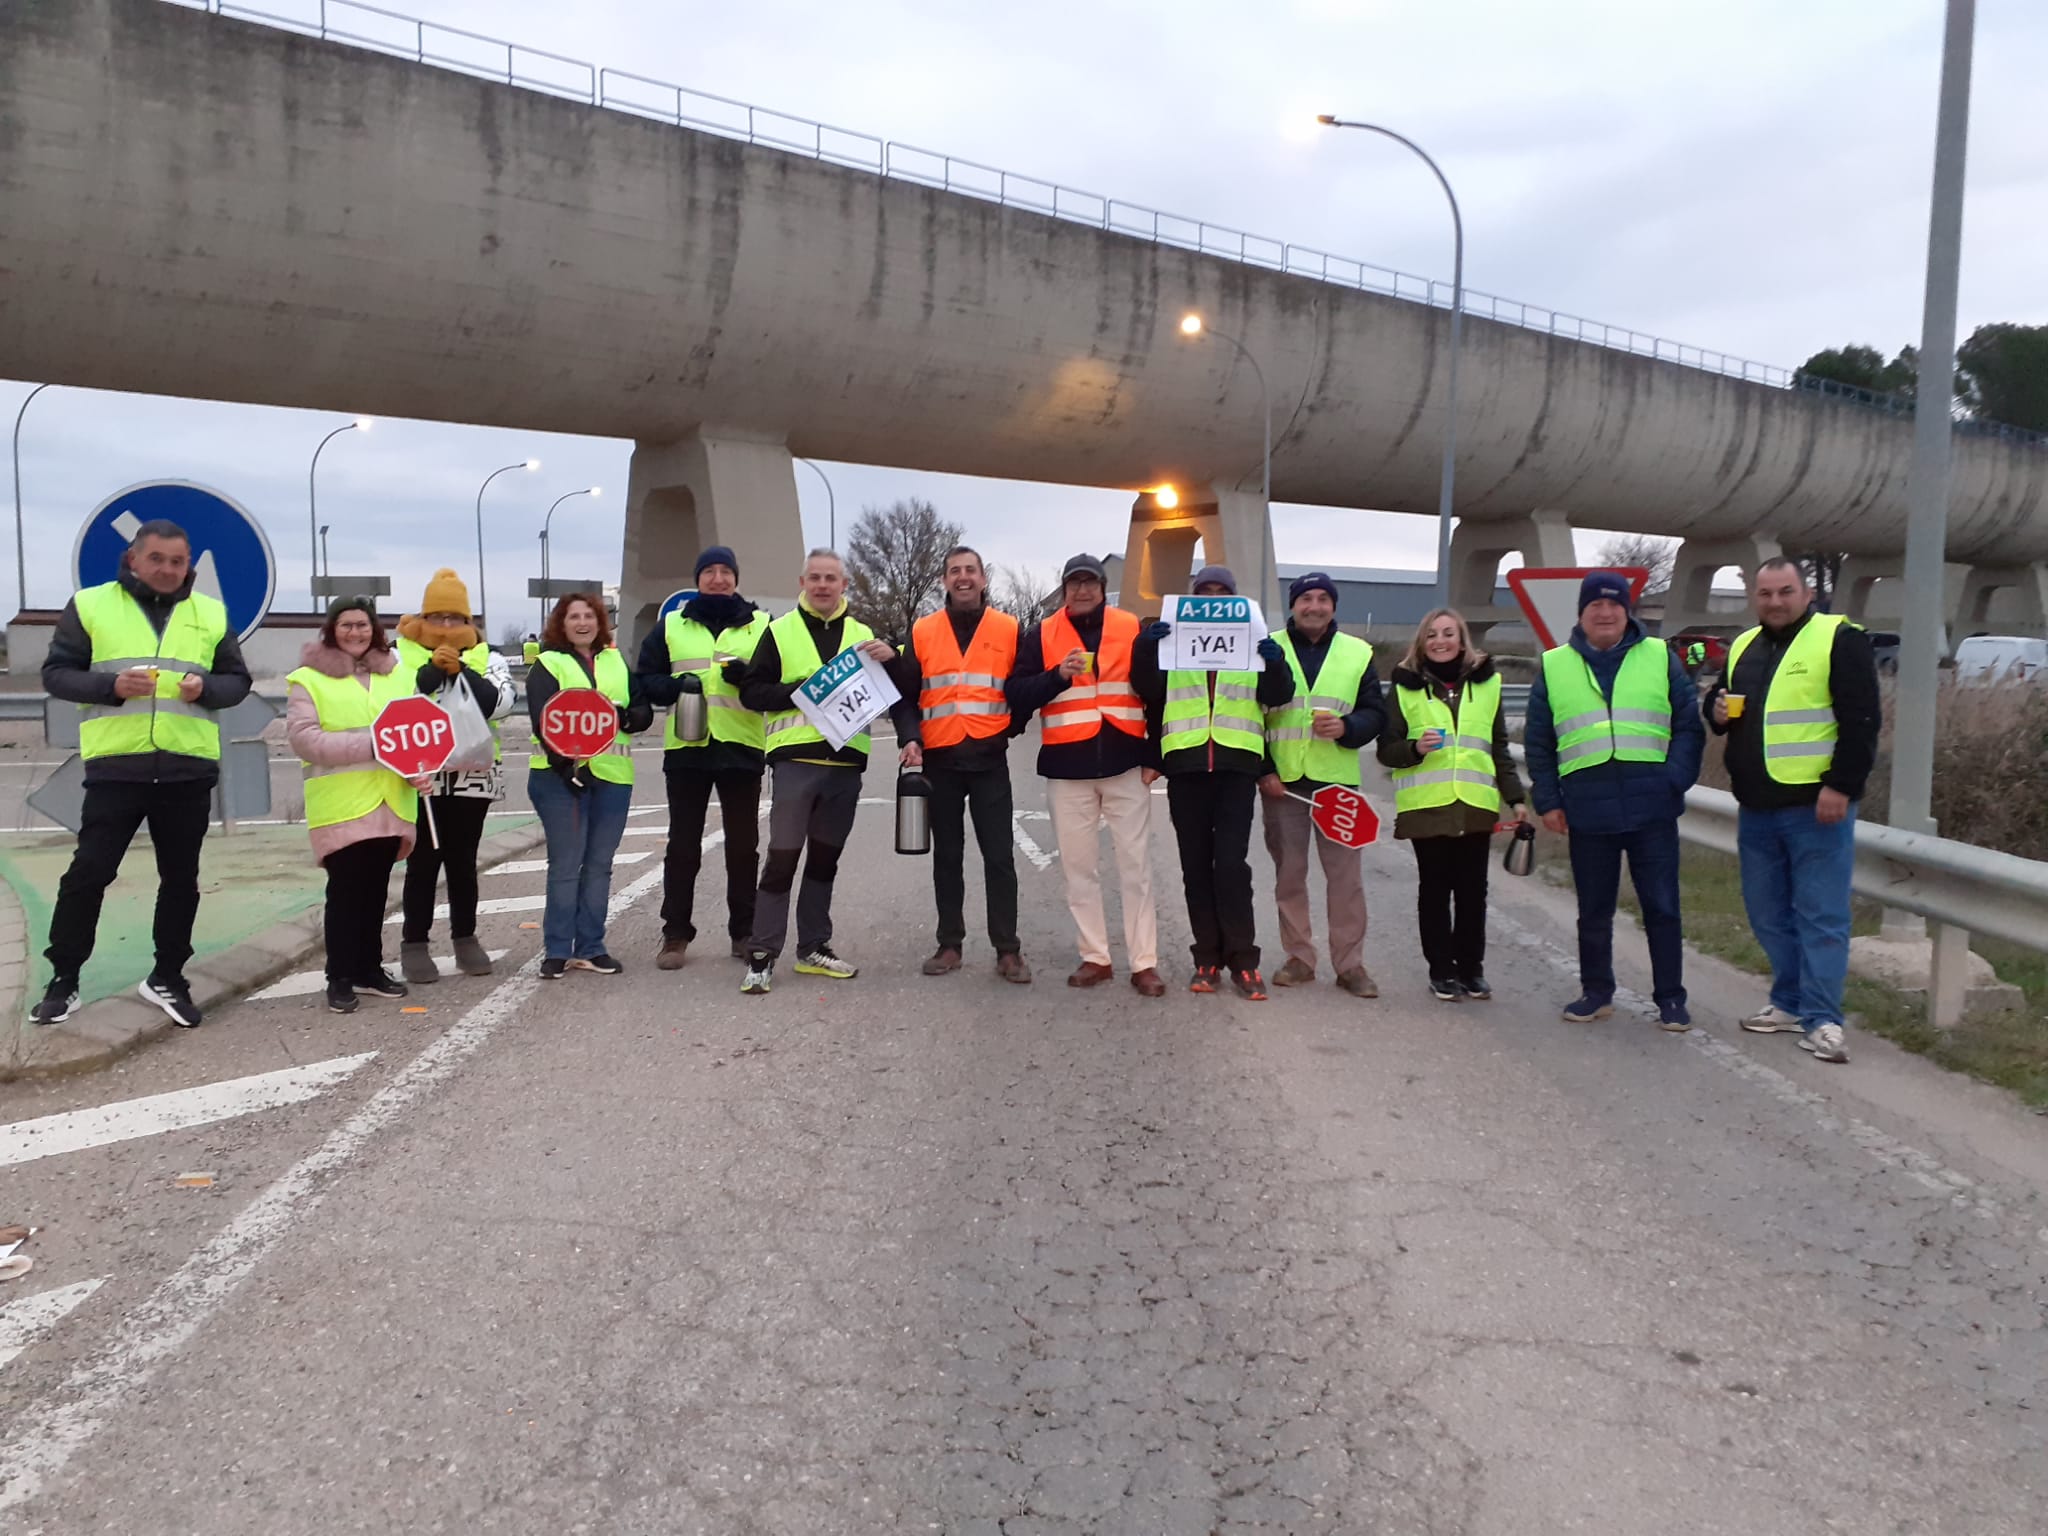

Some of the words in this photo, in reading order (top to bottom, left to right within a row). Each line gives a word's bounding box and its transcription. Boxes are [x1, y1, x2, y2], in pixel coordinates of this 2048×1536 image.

[1180, 601, 1246, 618] A-1210
[1191, 635, 1235, 657] ¡YA!
[808, 653, 856, 699] A-1210
[838, 684, 871, 722] ¡YA!
[379, 718, 447, 753] STOP
[547, 709, 613, 736] STOP
[1331, 791, 1359, 842] STOP
